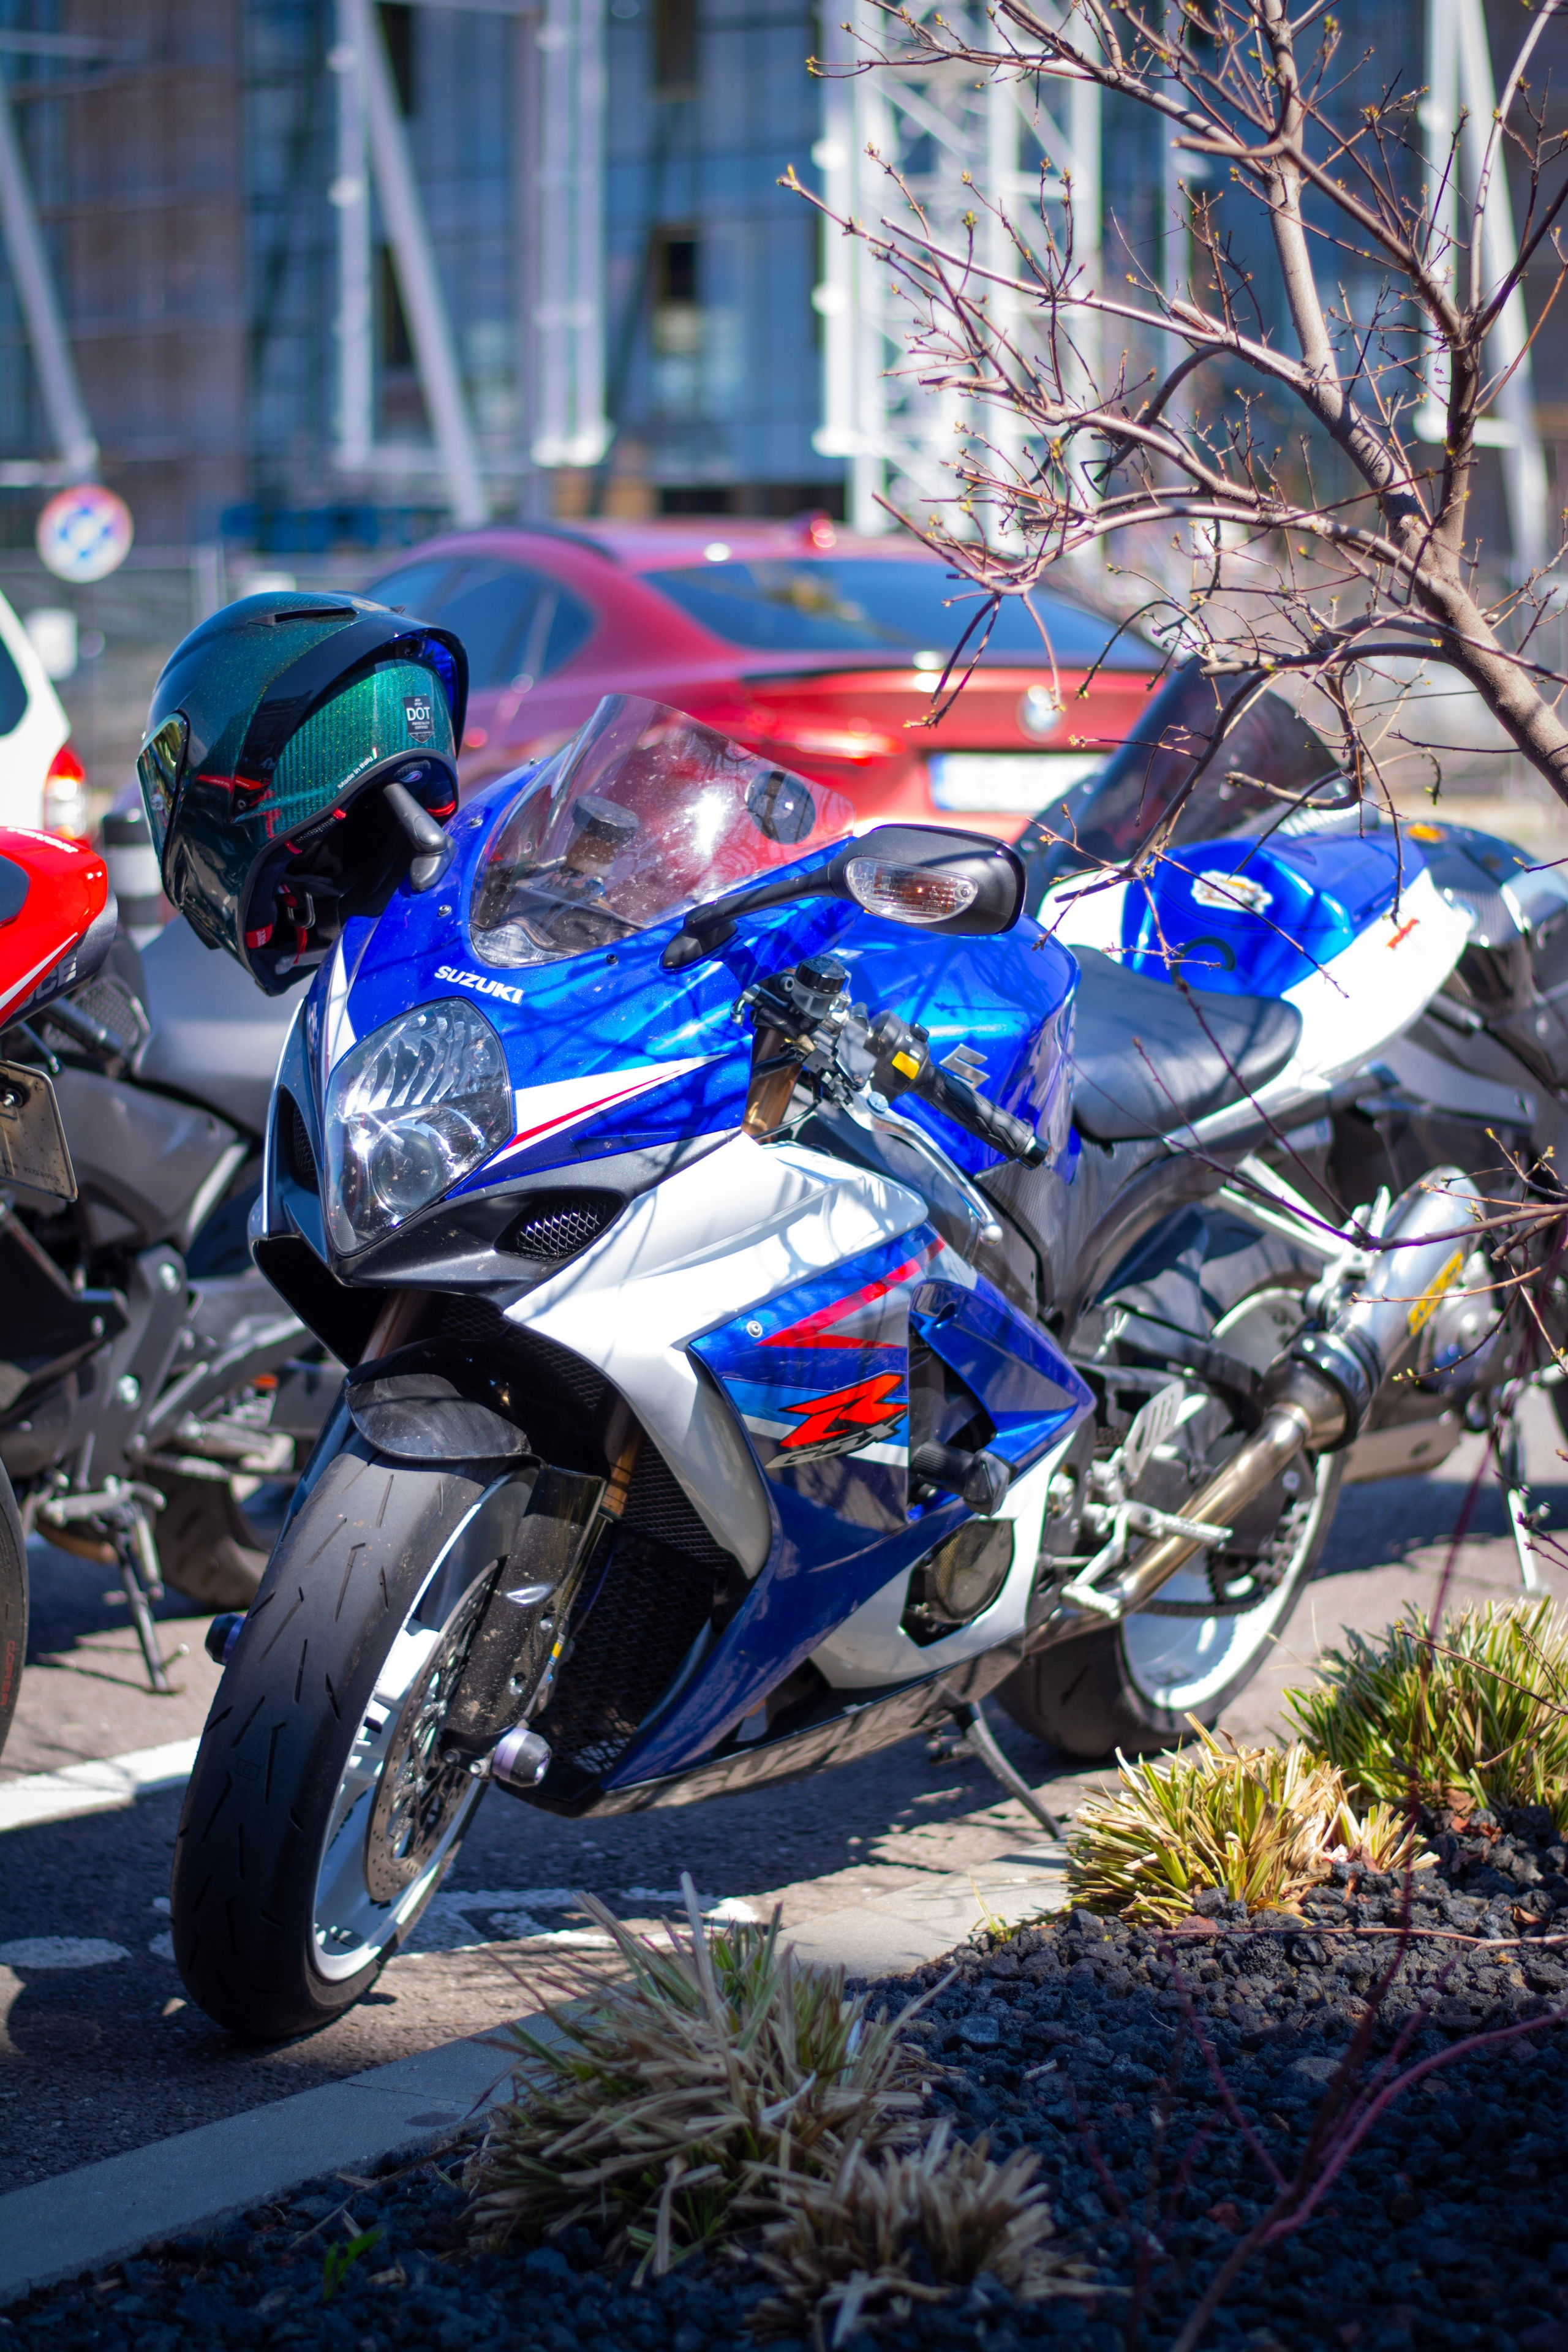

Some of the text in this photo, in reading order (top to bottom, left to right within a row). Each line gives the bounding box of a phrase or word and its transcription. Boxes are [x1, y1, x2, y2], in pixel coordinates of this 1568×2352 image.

[406, 706, 430, 721] DOT
[337, 773, 355, 789] Made
[359, 756, 374, 769] Italy
[434, 966, 524, 1005] SUZUKI
[682, 1677, 951, 1797] SUZUKI
